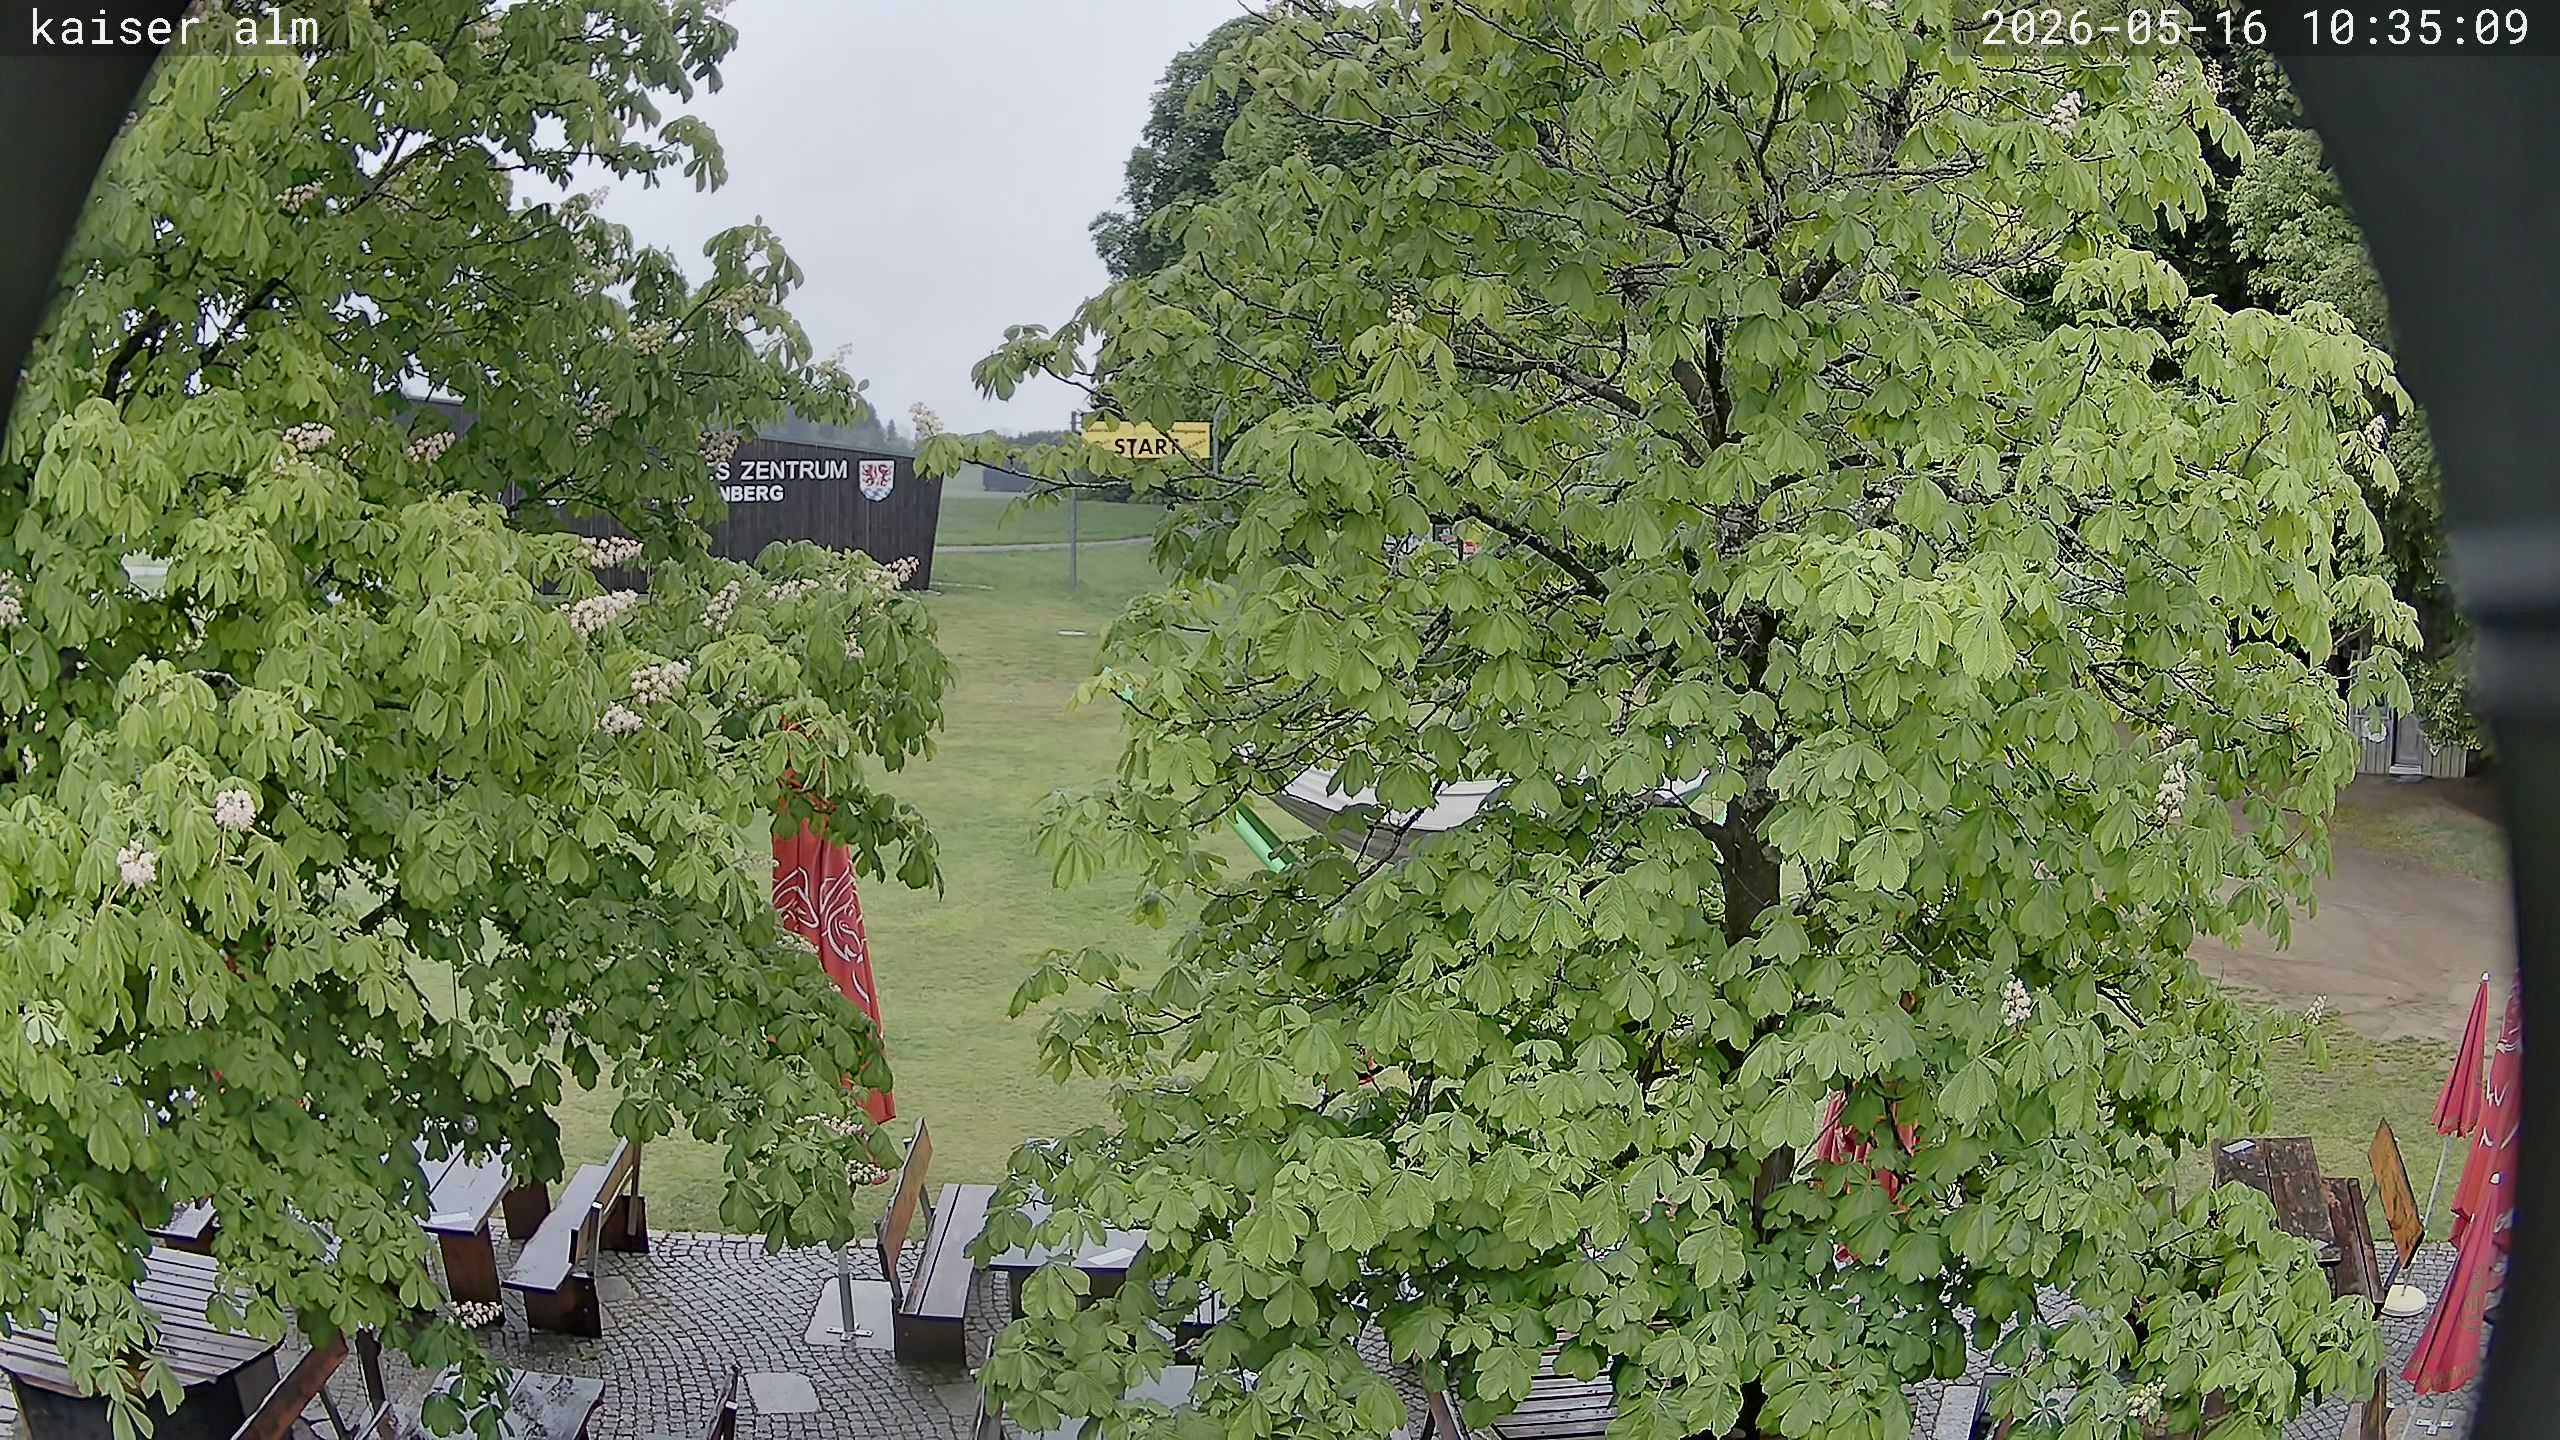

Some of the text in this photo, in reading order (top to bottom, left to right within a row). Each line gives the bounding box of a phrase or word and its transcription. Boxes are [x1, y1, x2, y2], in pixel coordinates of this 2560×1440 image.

[1114, 438, 1180, 455] START
[709, 460, 848, 480] S ZENTRUM
